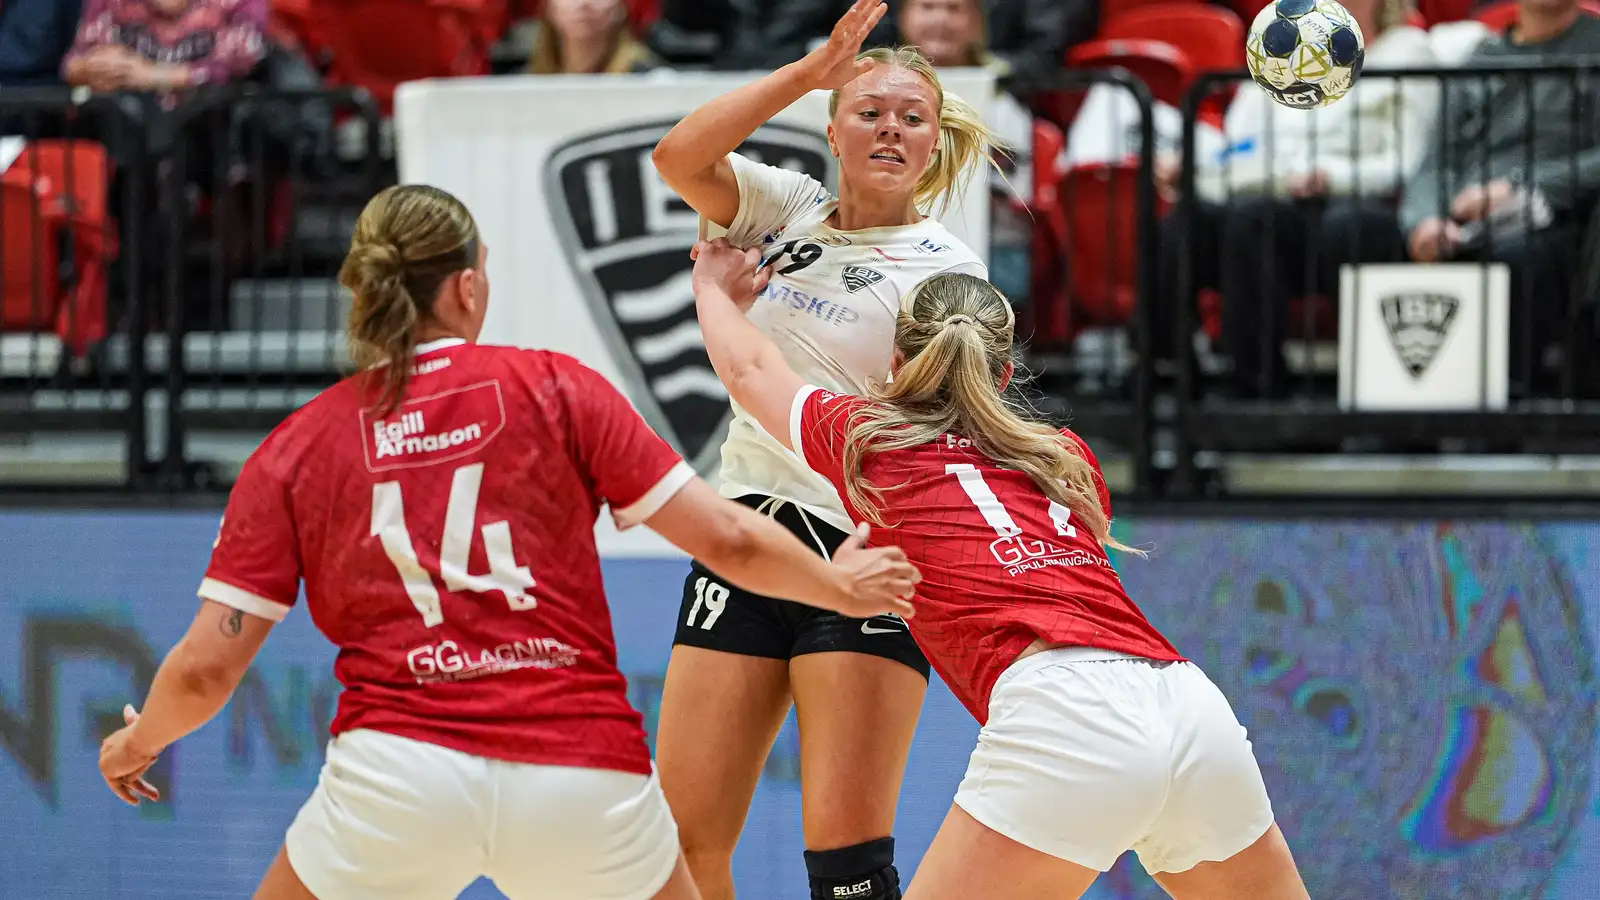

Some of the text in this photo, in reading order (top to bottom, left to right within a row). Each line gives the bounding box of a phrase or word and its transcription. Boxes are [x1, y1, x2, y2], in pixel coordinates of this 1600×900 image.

[760, 282, 859, 328] MSKIP
[373, 409, 425, 447] Egill
[376, 422, 482, 459] Arnason
[370, 462, 537, 628] 14
[686, 576, 730, 630] 19
[833, 879, 872, 896] SELECT
